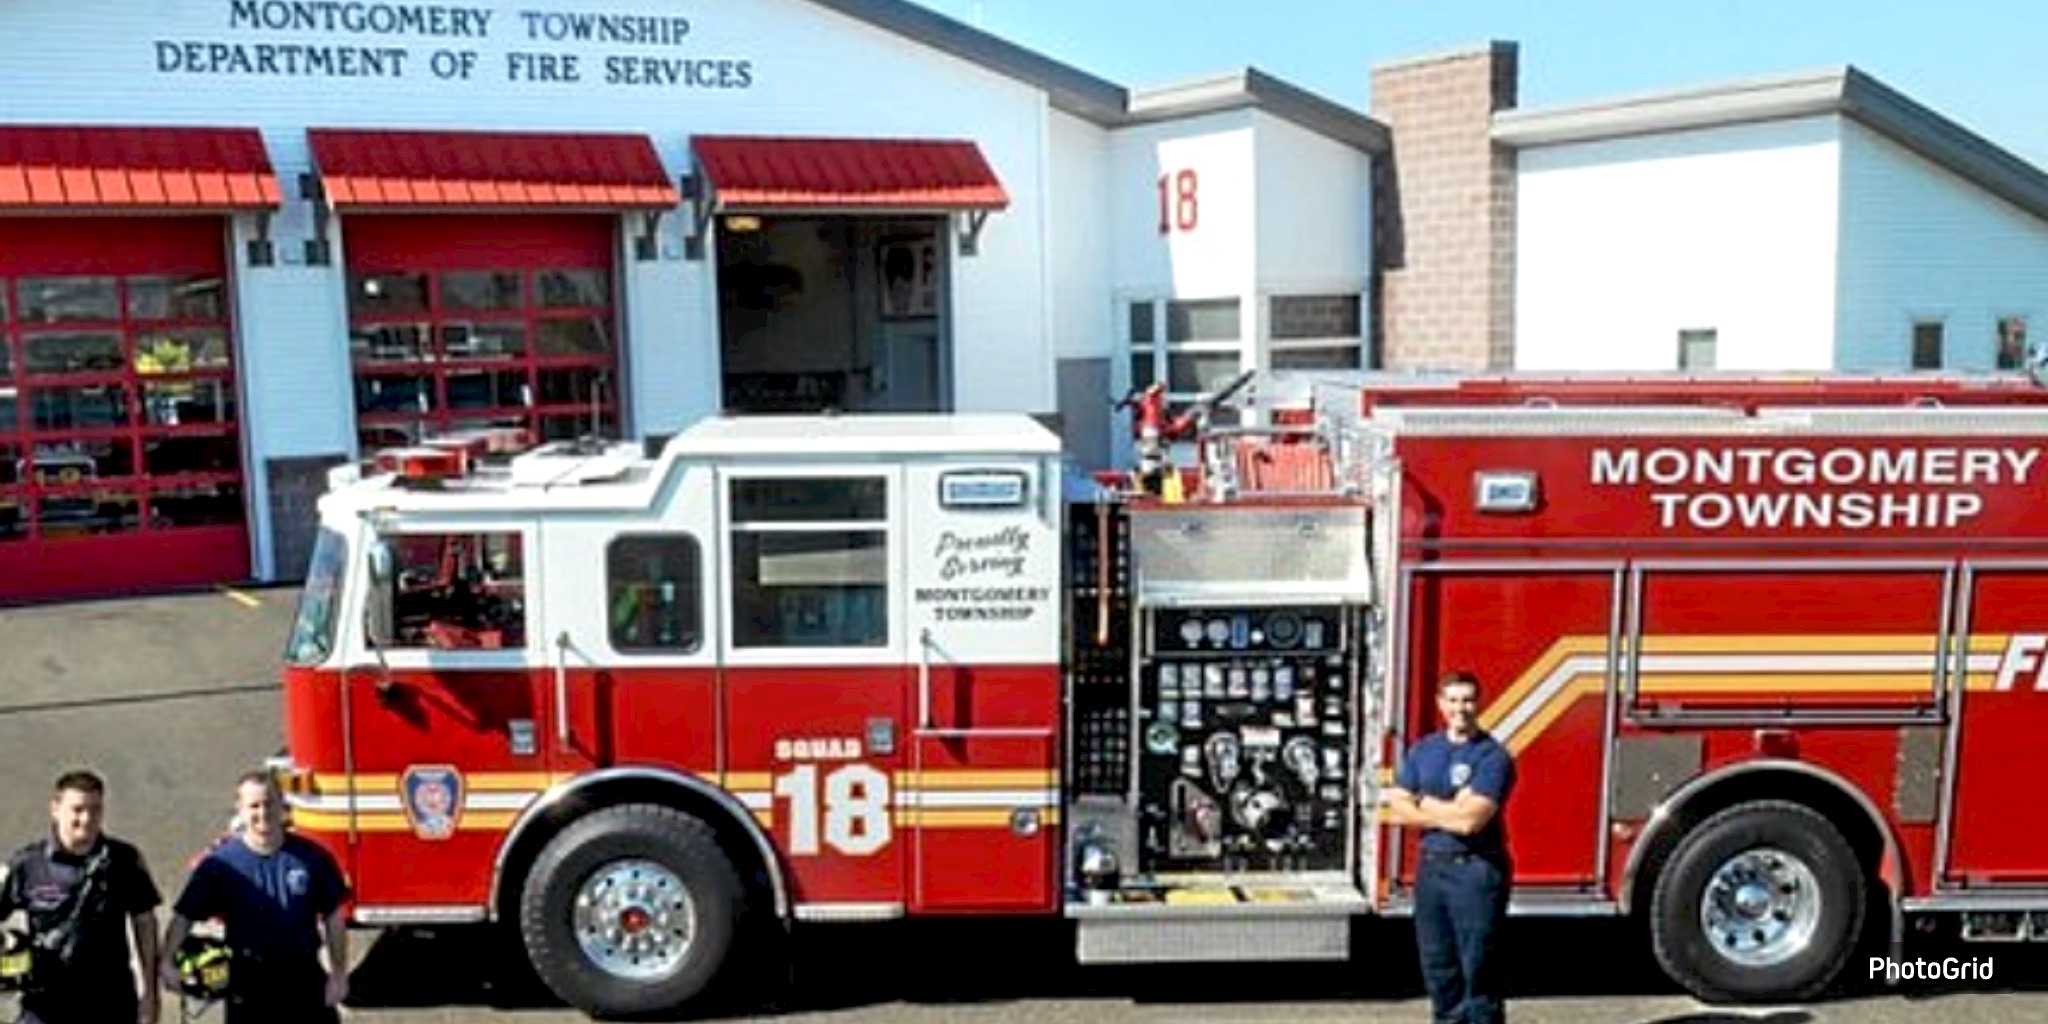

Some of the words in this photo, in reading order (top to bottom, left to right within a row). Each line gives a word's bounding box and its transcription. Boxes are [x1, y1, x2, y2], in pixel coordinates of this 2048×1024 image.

[229, 0, 492, 37] MONTGOMERY
[520, 11, 690, 45] TOWNSHIP
[155, 40, 408, 77] DEPARTMENT
[430, 49, 478, 80] OF
[507, 52, 580, 82] FIRE
[604, 55, 753, 88] SERVICES
[1158, 168, 1198, 236] 18
[1590, 448, 2039, 484] MONTGOMERY
[1651, 493, 1983, 528] TOWNSHIP
[914, 586, 1050, 602] MONTGOMERY
[933, 606, 1034, 621] TOWNSHIP
[774, 737, 863, 760] SQUAD
[774, 763, 893, 856] 18
